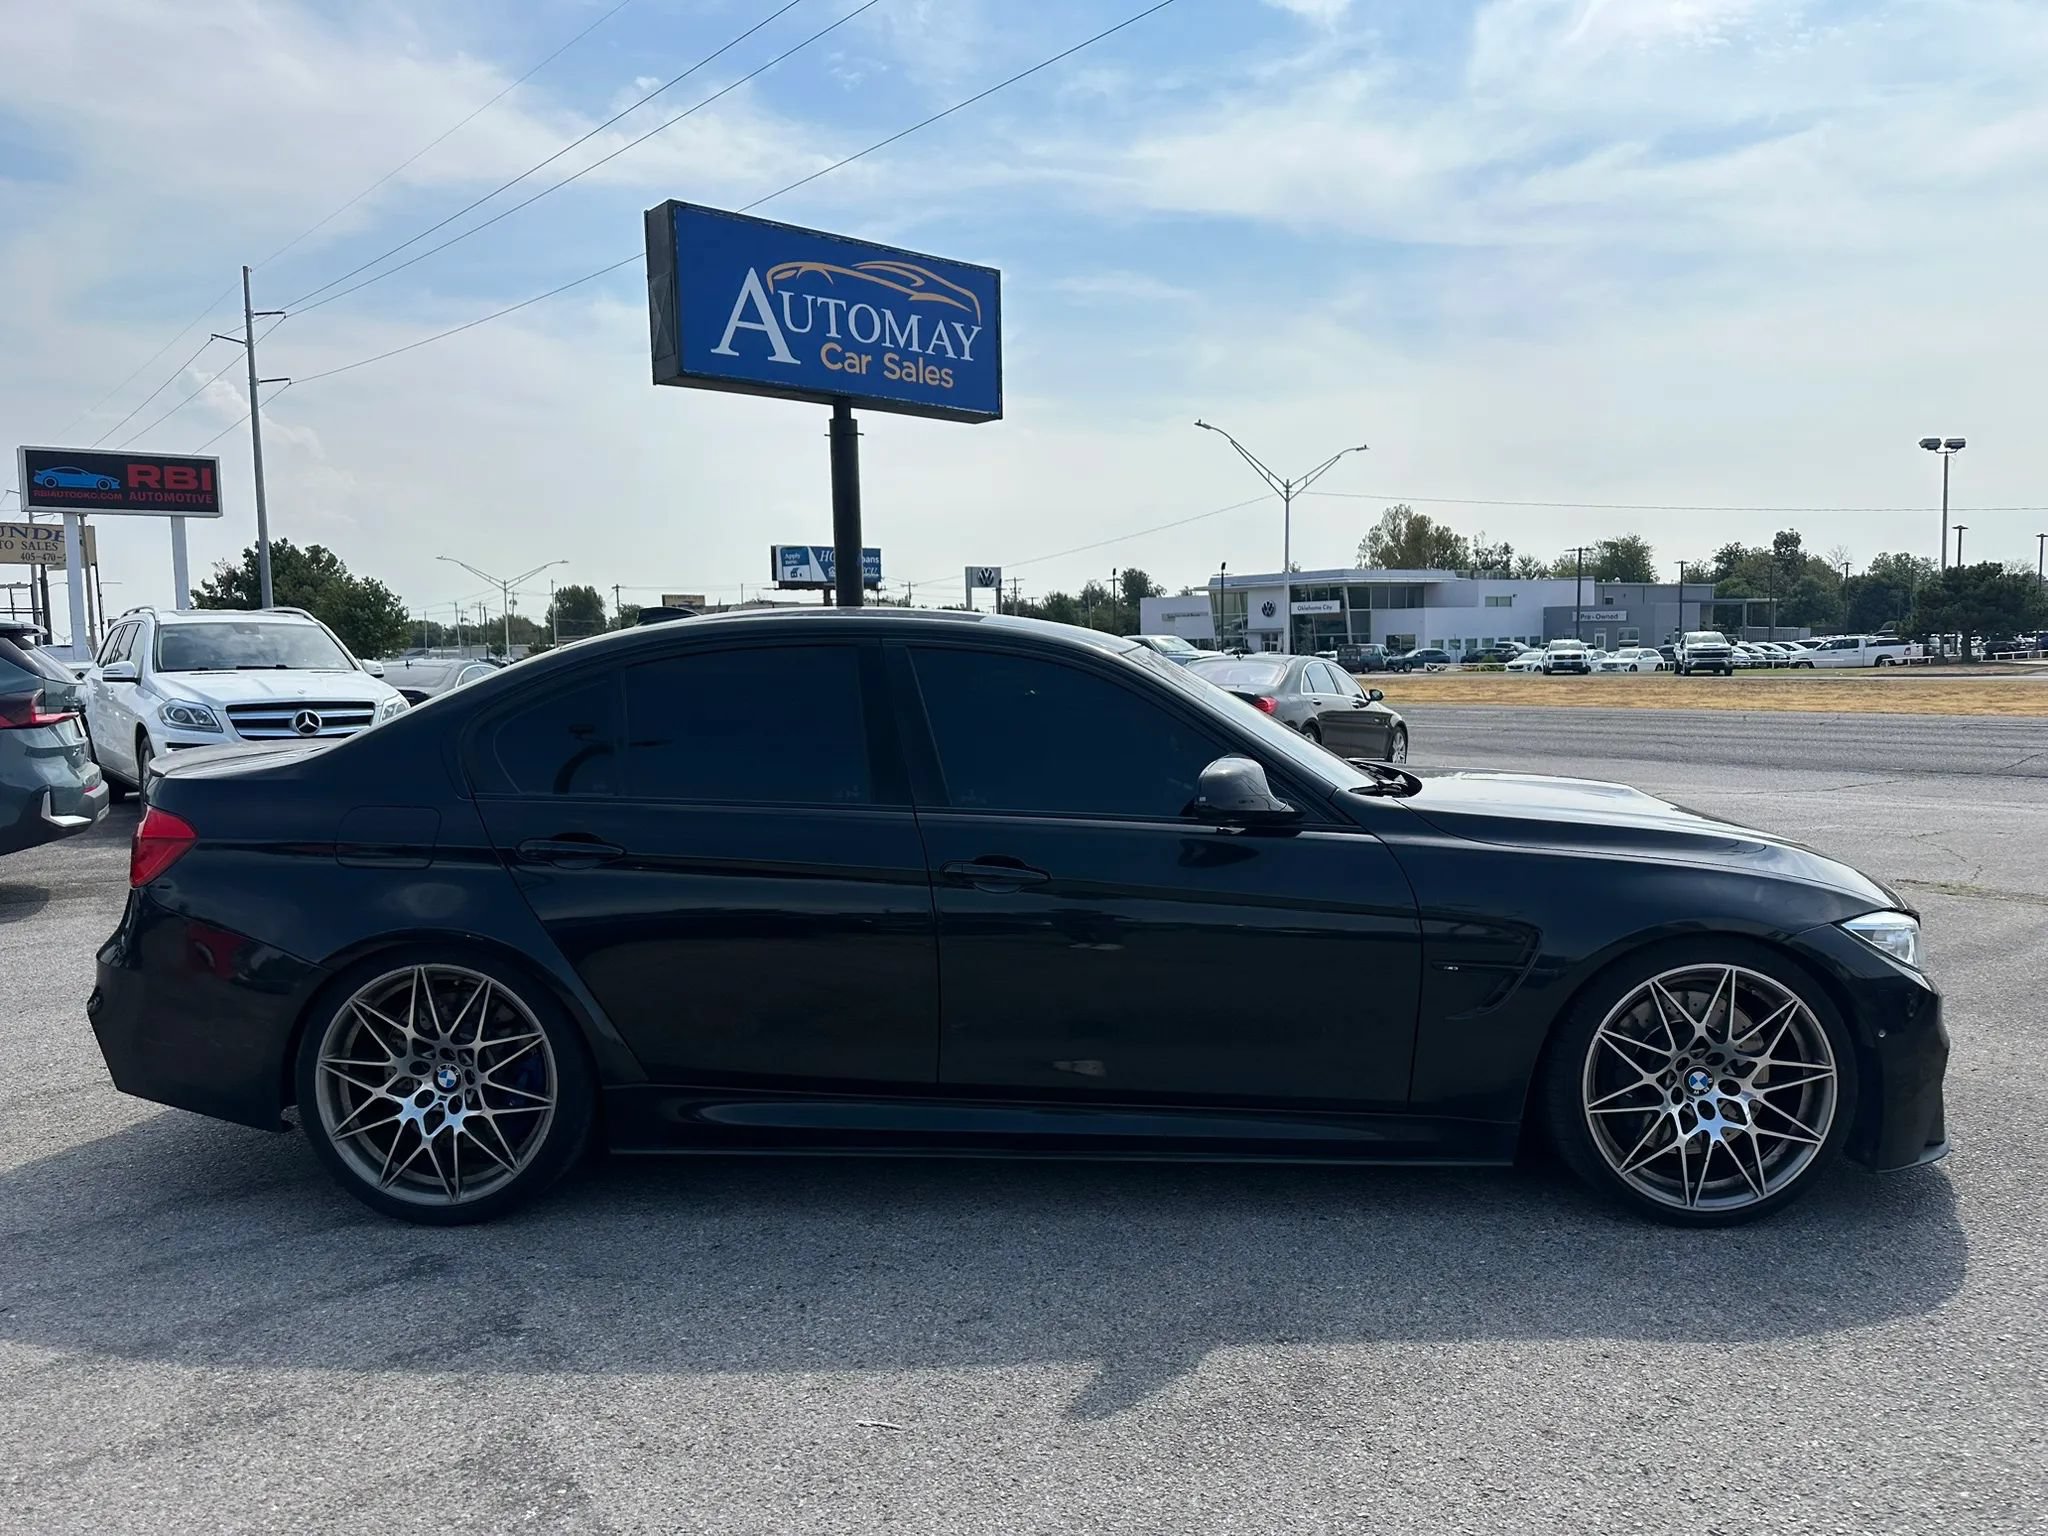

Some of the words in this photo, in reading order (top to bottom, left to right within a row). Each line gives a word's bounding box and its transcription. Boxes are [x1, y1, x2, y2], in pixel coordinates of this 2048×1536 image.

[820, 343, 872, 375] Car
[883, 352, 954, 389] Sales
[127, 464, 212, 491] RBI
[129, 492, 213, 504] AUTOMOTIVE
[21, 541, 58, 551] SALES
[784, 552, 801, 560] Apply
